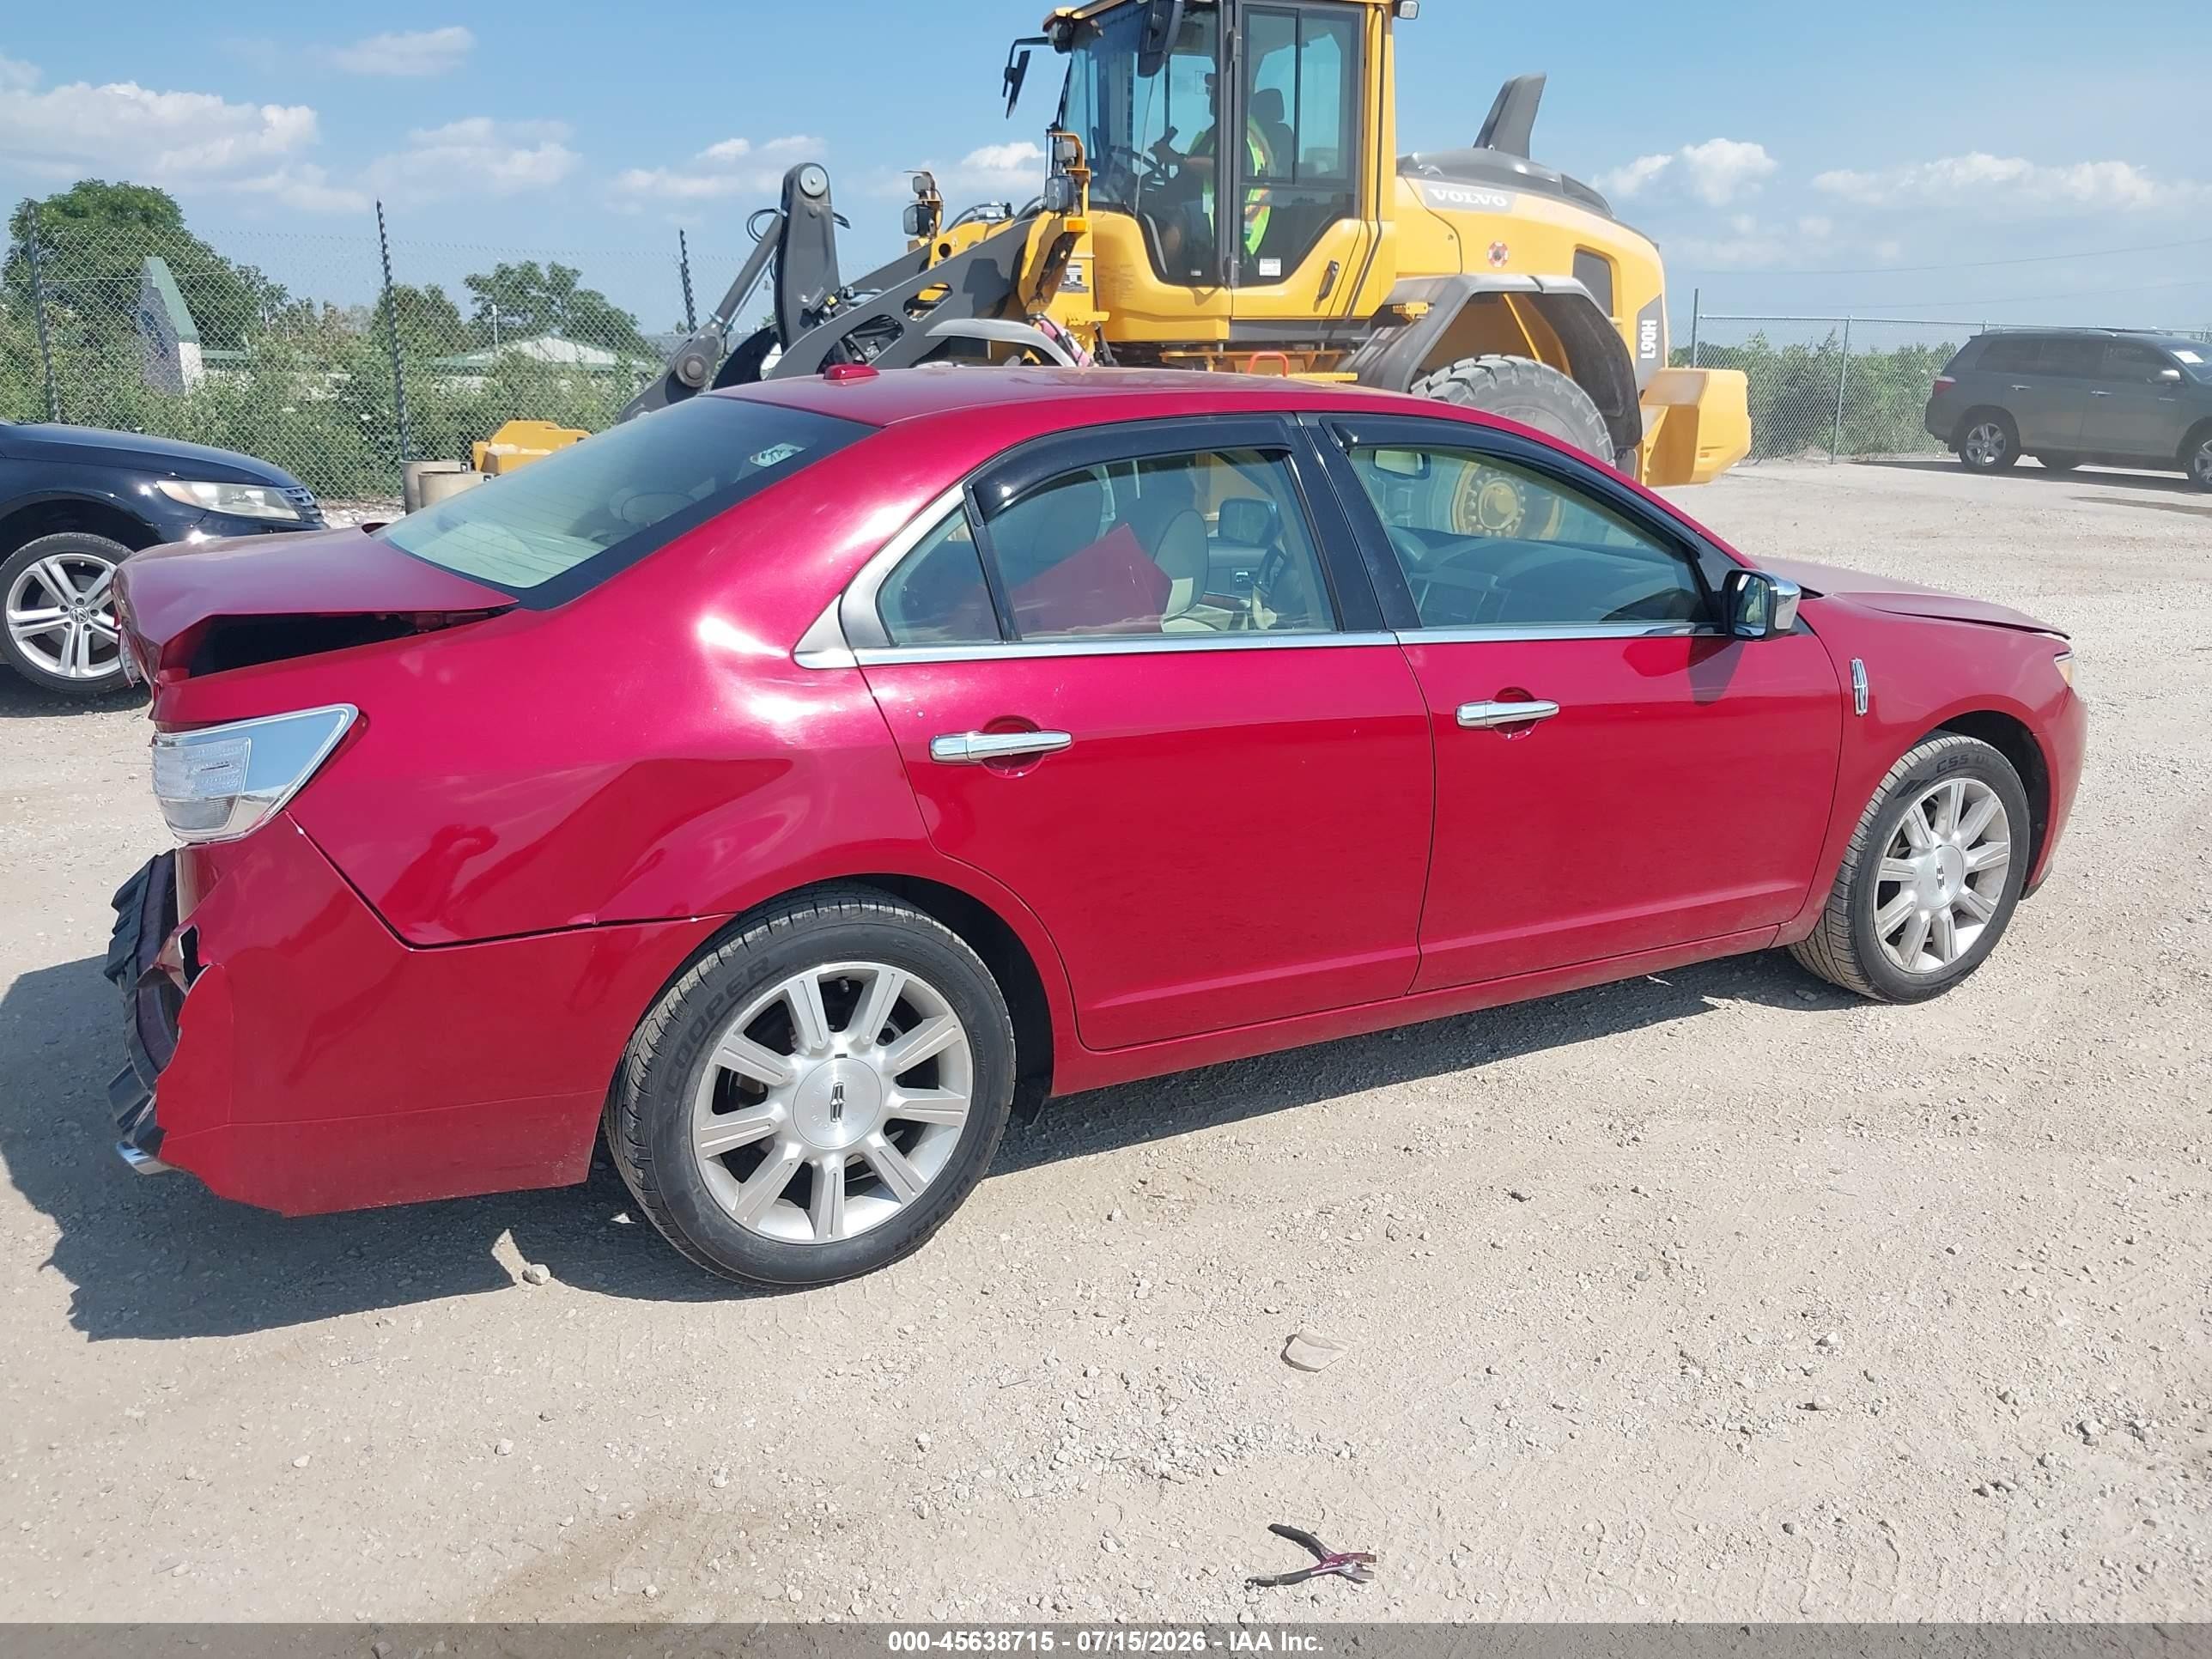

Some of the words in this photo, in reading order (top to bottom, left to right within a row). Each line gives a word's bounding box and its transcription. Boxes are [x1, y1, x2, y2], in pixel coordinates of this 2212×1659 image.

[1428, 188, 1508, 207] VOLVO
[1640, 319, 1657, 359] L90H
[665, 956, 770, 1094] COOPER
